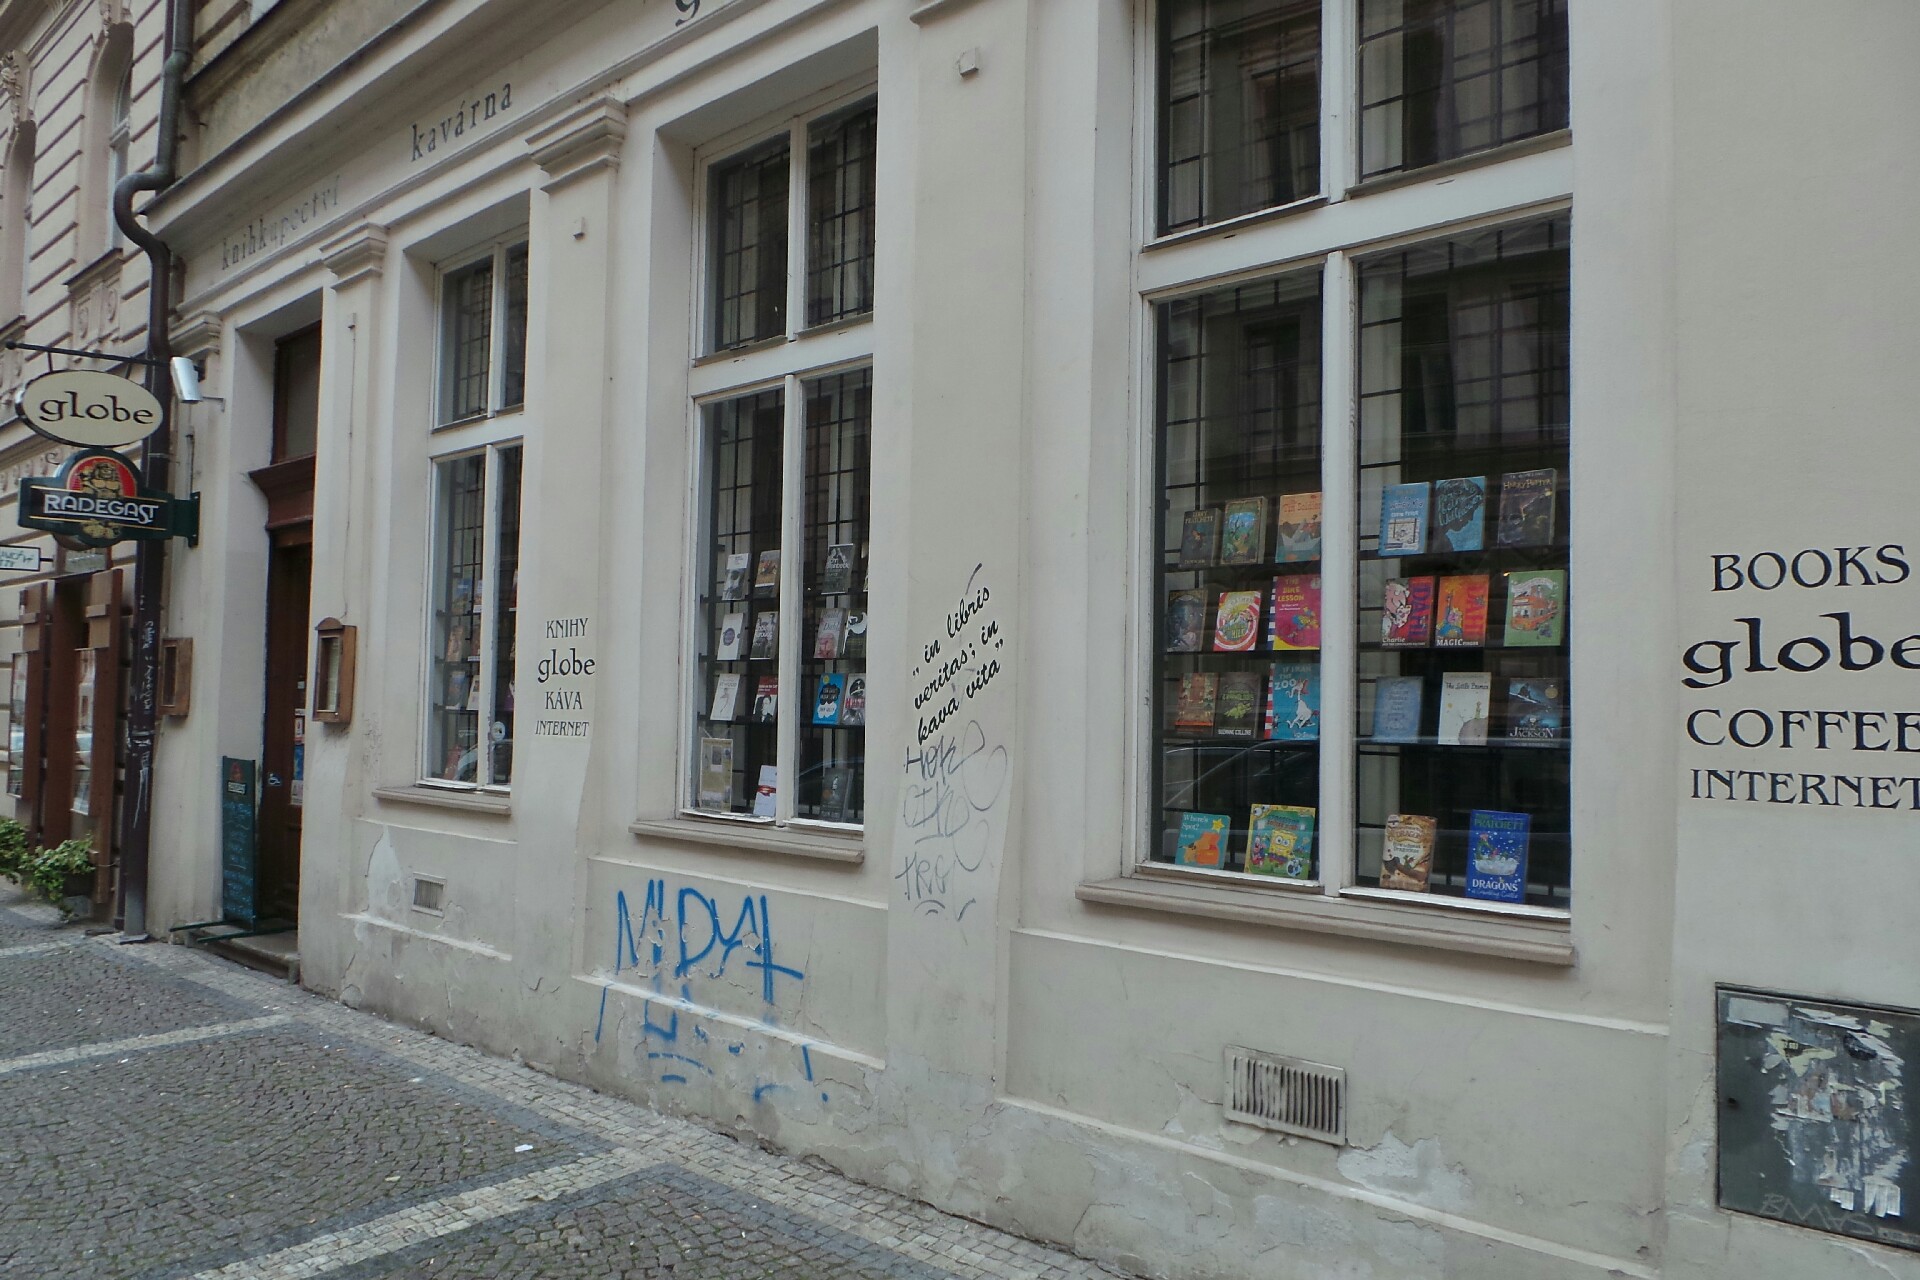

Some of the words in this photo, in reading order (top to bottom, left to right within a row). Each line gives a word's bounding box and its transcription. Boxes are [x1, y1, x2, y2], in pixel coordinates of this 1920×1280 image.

[411, 82, 512, 162] kavárna
[38, 391, 154, 424] globe
[44, 494, 159, 524] RADEGAST
[1710, 544, 1911, 592] BOOKS
[546, 618, 588, 639] KNIHY
[947, 586, 989, 638] libris
[981, 620, 999, 645] in
[538, 648, 595, 683] globe
[1681, 611, 1920, 689] globe
[545, 688, 583, 710] KÁVA
[1274, 679, 1297, 690] ZOO
[535, 720, 589, 737] INTERNET
[918, 697, 960, 746] kava
[1509, 727, 1554, 738] JACKSON
[1687, 709, 1920, 753] COFFEE
[1690, 768, 1920, 810] INTERNET
[1472, 878, 1518, 892] DRAGONS
